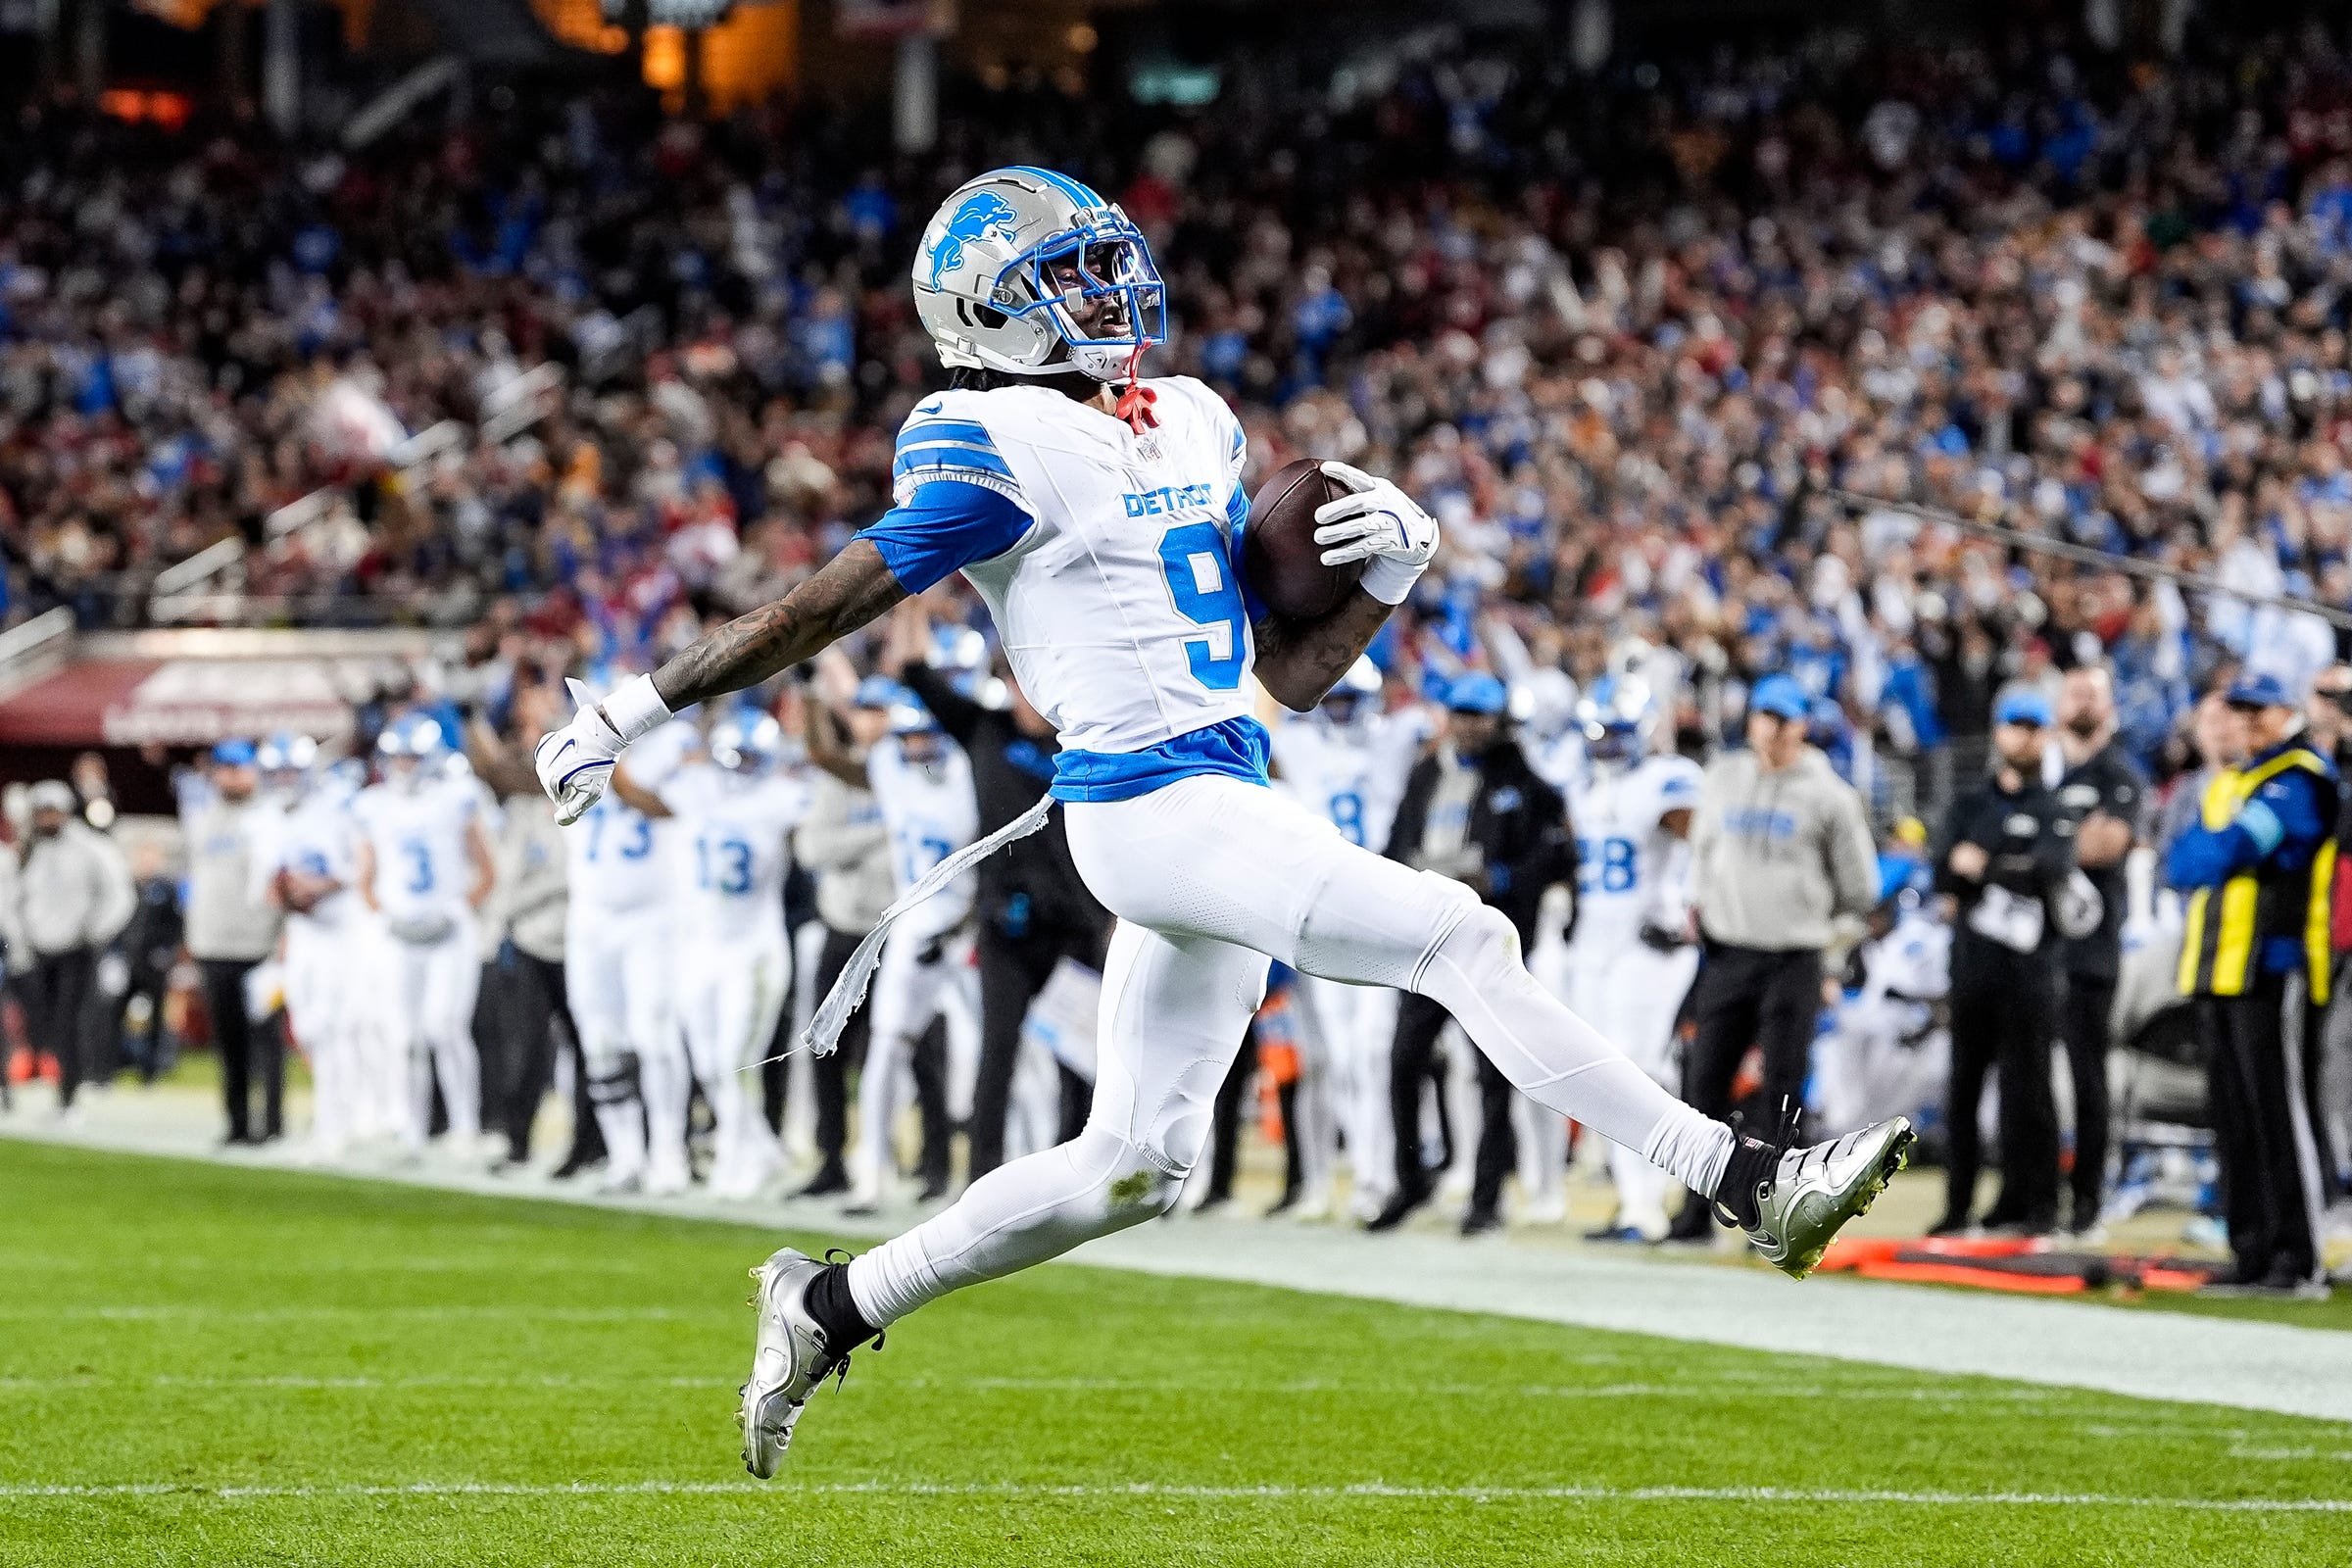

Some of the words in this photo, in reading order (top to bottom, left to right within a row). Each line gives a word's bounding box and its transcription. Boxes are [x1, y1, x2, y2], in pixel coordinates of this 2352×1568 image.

[1157, 520, 1247, 691] 9
[402, 835, 435, 895] 3
[694, 837, 754, 895] 13
